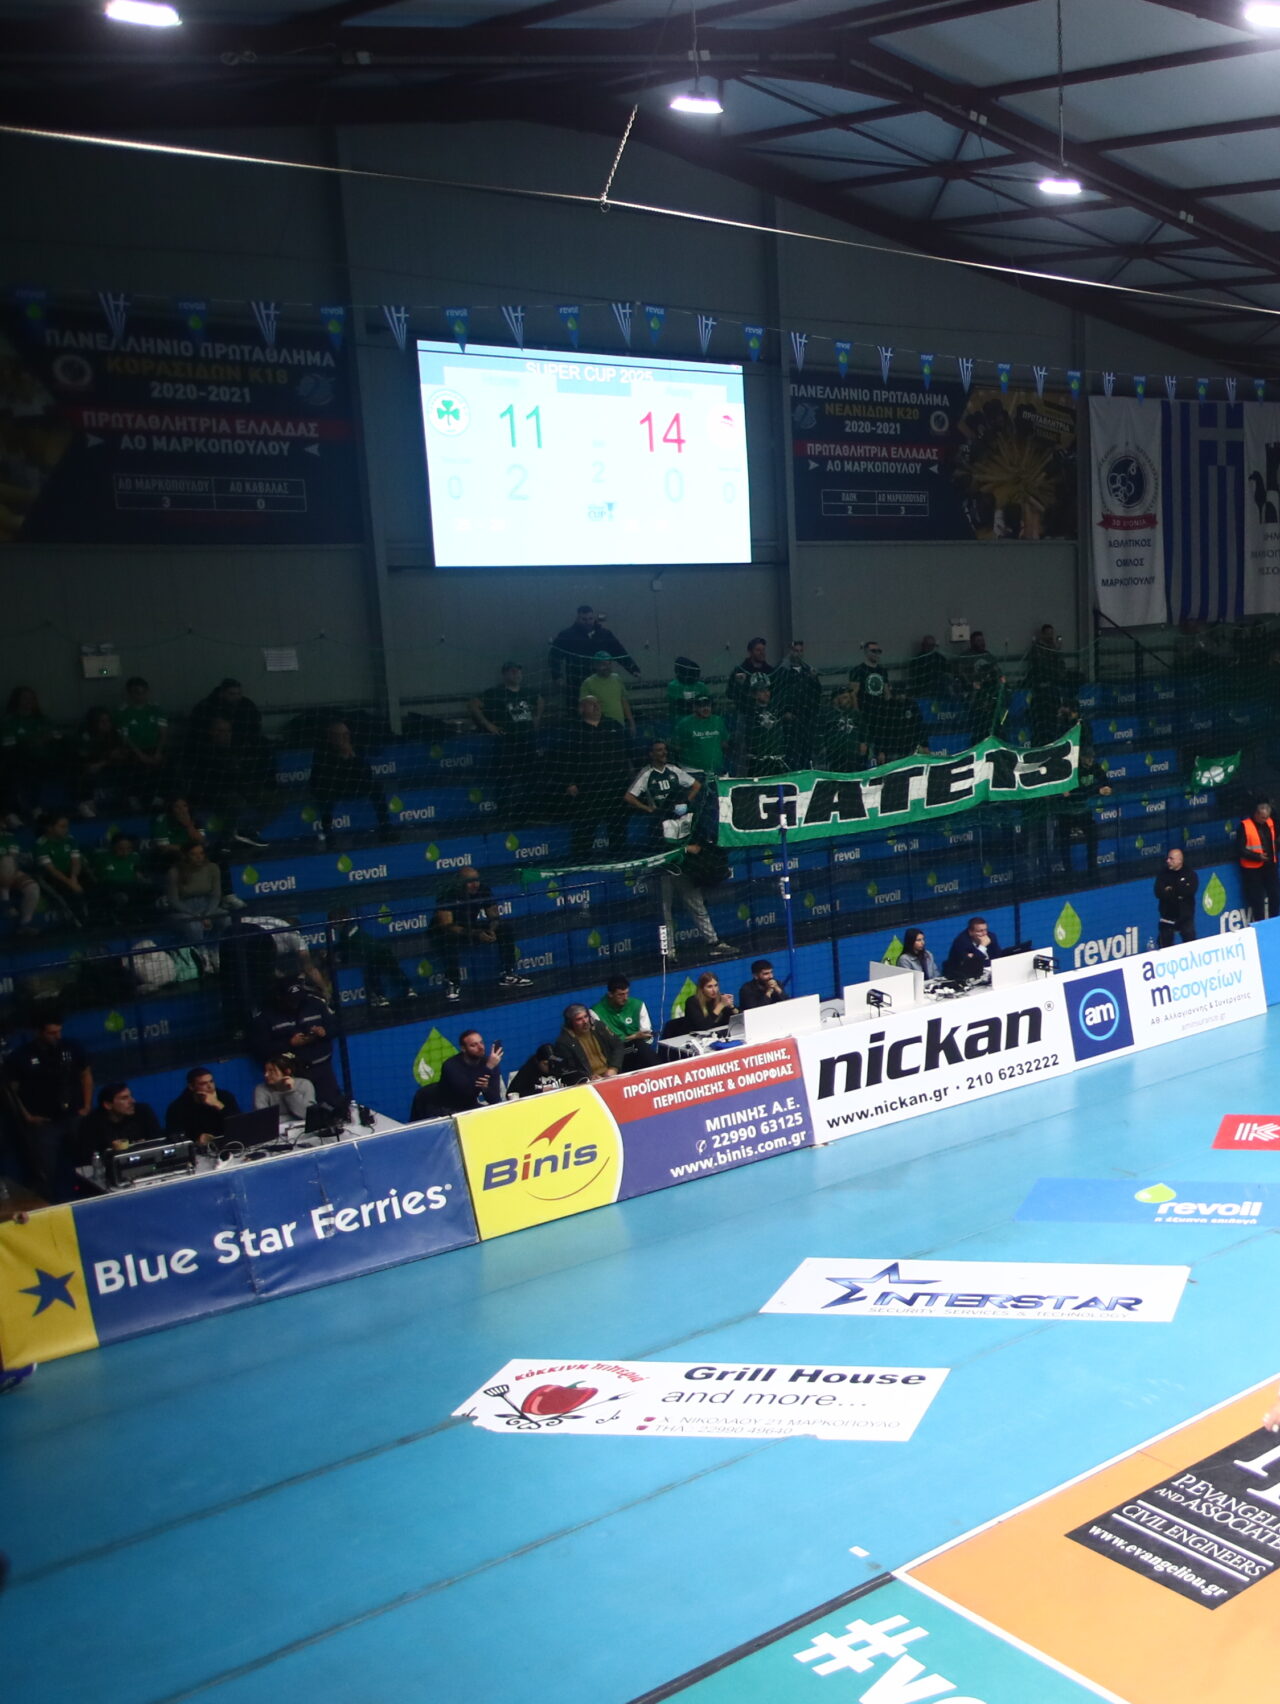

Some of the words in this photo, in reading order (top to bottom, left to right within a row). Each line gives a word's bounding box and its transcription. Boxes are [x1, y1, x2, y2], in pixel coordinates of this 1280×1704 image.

[525, 361, 581, 380] SUPER
[584, 366, 616, 382] CUP
[620, 369, 654, 384] 2025
[150, 381, 252, 403] 2020-2021
[789, 383, 870, 402] ΠΑΝΕΛΛΗΝΙΟ
[872, 389, 950, 407] ΠΡΩΤΑΘΛΗΜΑ
[825, 403, 893, 419] ΝΕΑΝΙΔΩΝ
[82, 411, 231, 434] ΠΡΩΤΑΘΛΗΤΡΙΑ
[235, 418, 320, 438] ΕΛΛΑΔΑΣ
[499, 403, 544, 449] 11
[639, 411, 687, 453] 14
[844, 420, 901, 434] 2020-2021
[152, 435, 291, 457] ΜΑΡΚΟΠΟΥΛΟΥ
[806, 443, 889, 458] ΠΡΩΤΑΘΛΗΤΡΙΑ
[890, 447, 939, 460] ΕΛΛΑΔΑΣ
[844, 460, 922, 474] ΜΑΡΚΟΠΟΥΛΟΥ
[399, 806, 436, 822] revoil
[436, 853, 472, 870] revoil
[515, 843, 550, 859] revoil
[834, 848, 861, 862] revoil
[348, 866, 388, 881] revoil
[254, 876, 296, 894] revoil
[1074, 926, 1139, 968] revoil
[517, 952, 554, 970] revoil
[1084, 1001, 1115, 1027] am
[817, 1006, 1043, 1101] nickan
[623, 1073, 683, 1099] ΠΡΟΪΟΝΤΑ
[684, 1060, 741, 1085] ΑΤΟΜΙΚΗΣ
[741, 1048, 791, 1073] ΥΓΙΕΙΝΗΣ,
[653, 1081, 726, 1110] ΠΕΡΙΠΟΙΗΣΗΣ
[727, 1079, 736, 1091] &
[737, 1063, 795, 1089] ΟΜΟΡΦΙΑΣ
[826, 1086, 950, 1129] www.nickan.gr
[966, 1071, 994, 1091] 210
[998, 1053, 1060, 1082] 6232222
[705, 1106, 769, 1132] ΜΠΙΝΗΣ
[772, 1097, 801, 1116] Α.Ε.
[711, 1126, 757, 1149] 22990
[760, 1112, 804, 1136] 63125
[670, 1130, 807, 1179] www.binis.com.gr
[482, 1142, 598, 1191] Binis
[1157, 1201, 1263, 1216] revoil
[94, 1247, 199, 1295] Blue
[213, 1219, 298, 1264] Star
[310, 1182, 449, 1240] Ferries
[869, 1307, 936, 1315] SECURITY
[944, 1309, 1009, 1317] SERVICES
[875, 1291, 1143, 1312] INTERSTAR
[684, 1366, 778, 1382] Grill
[787, 1368, 927, 1385] House
[662, 1389, 734, 1404] and
[743, 1392, 867, 1407] more...
[1155, 1487, 1185, 1508] AND
[1122, 1504, 1169, 1535] CIVIL
[1170, 1525, 1267, 1578] ENGINEERS
[1088, 1523, 1228, 1598] www.evangeliou.gr
